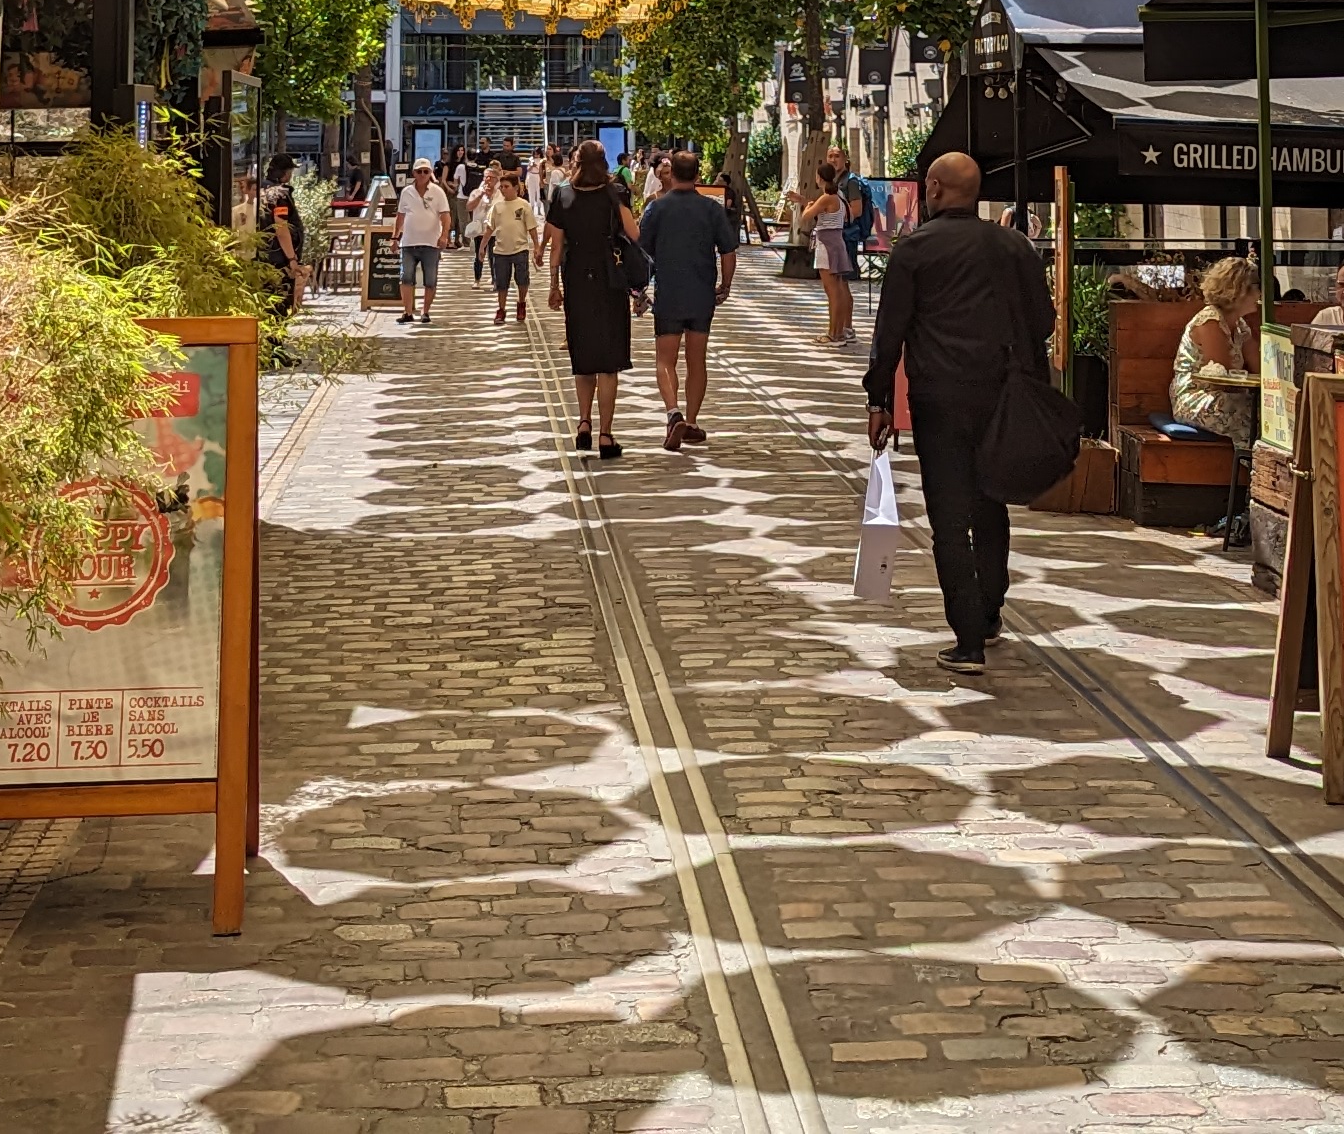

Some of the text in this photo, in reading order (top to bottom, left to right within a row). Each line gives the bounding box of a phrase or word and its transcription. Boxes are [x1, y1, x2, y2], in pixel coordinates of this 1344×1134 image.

[1173, 143, 1257, 170] GRILLED
[68, 698, 113, 710] PINTE
[129, 695, 204, 709] COCKTAILS
[17, 713, 51, 725] AVEC
[81, 711, 99, 723] DE
[129, 710, 165, 722] SANS
[65, 724, 113, 736] BIERE
[128, 723, 178, 735] ALCOOL
[8, 742, 50, 762] 7.20
[71, 740, 107, 760] 7.30
[127, 738, 164, 758] 5.50
